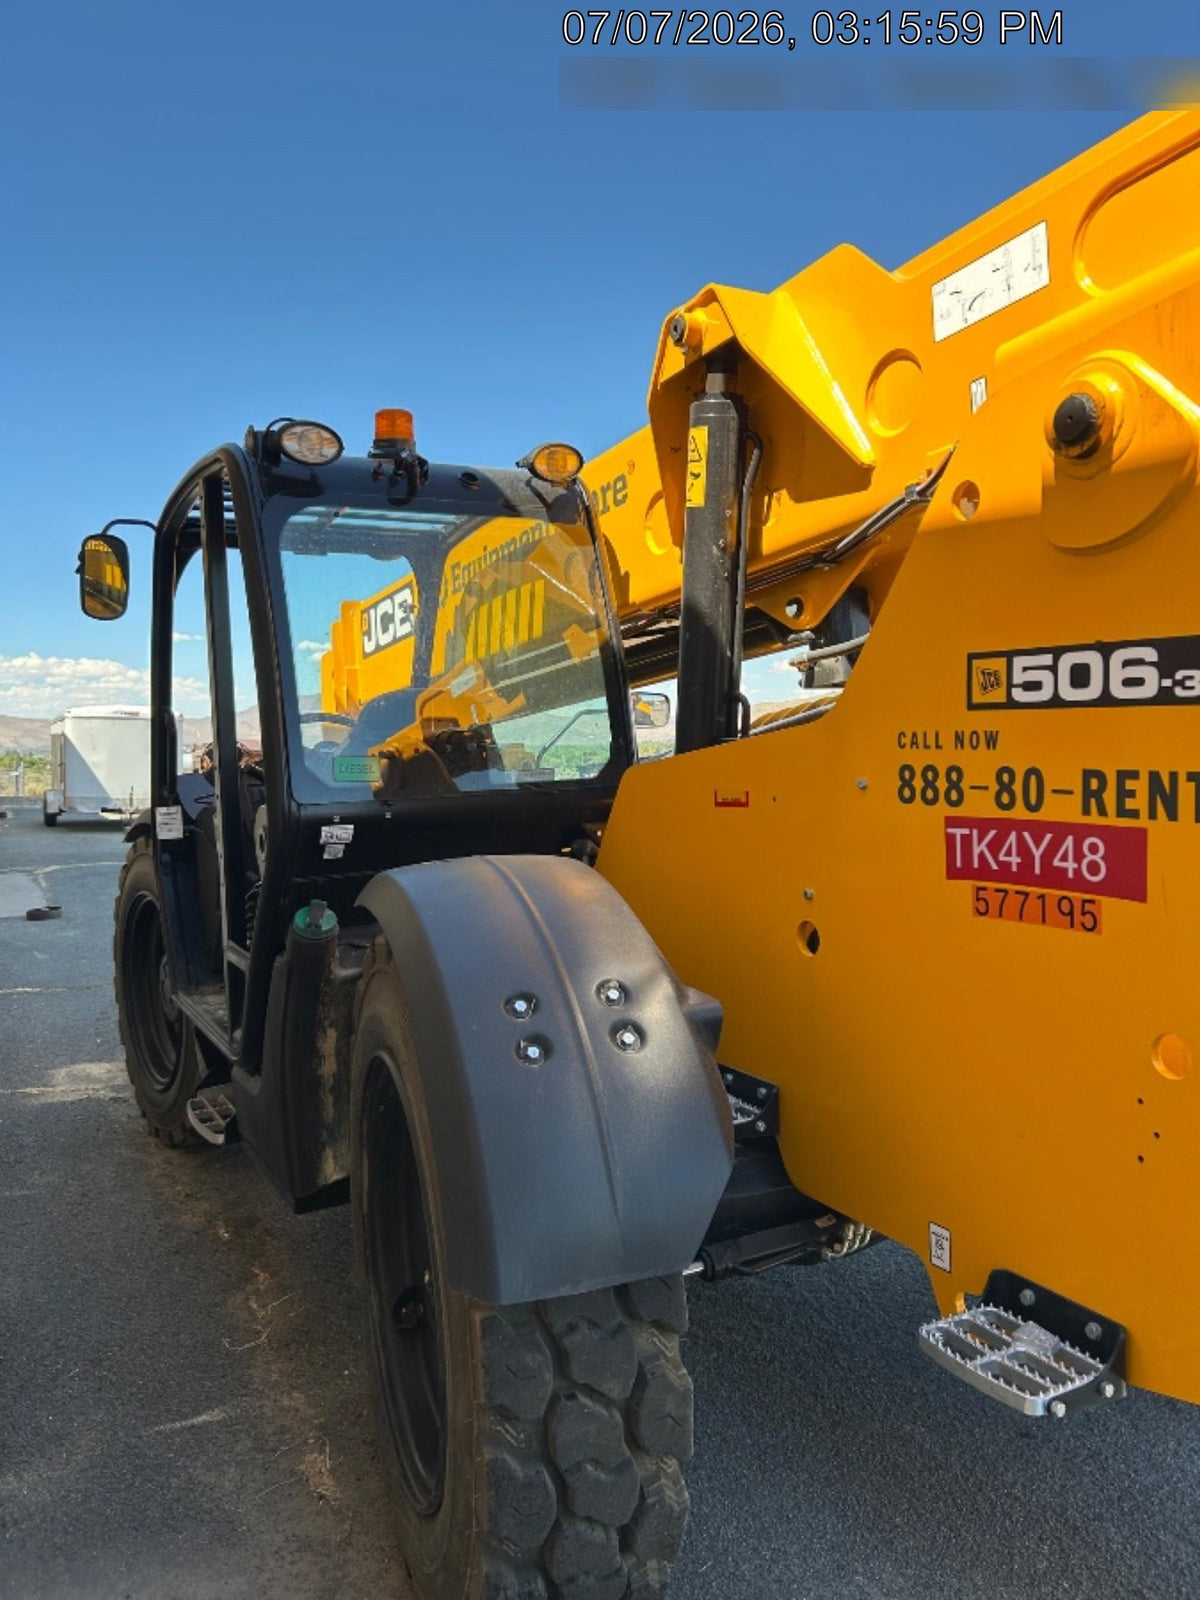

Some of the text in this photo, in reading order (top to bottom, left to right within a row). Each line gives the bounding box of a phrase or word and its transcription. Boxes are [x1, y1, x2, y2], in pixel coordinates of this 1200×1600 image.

[363, 588, 414, 653] JCB
[897, 730, 999, 750] CALL NOW
[338, 763, 376, 775] DIESEL
[946, 828, 1107, 882] TK4Y48
[974, 886, 1098, 932] 577195
